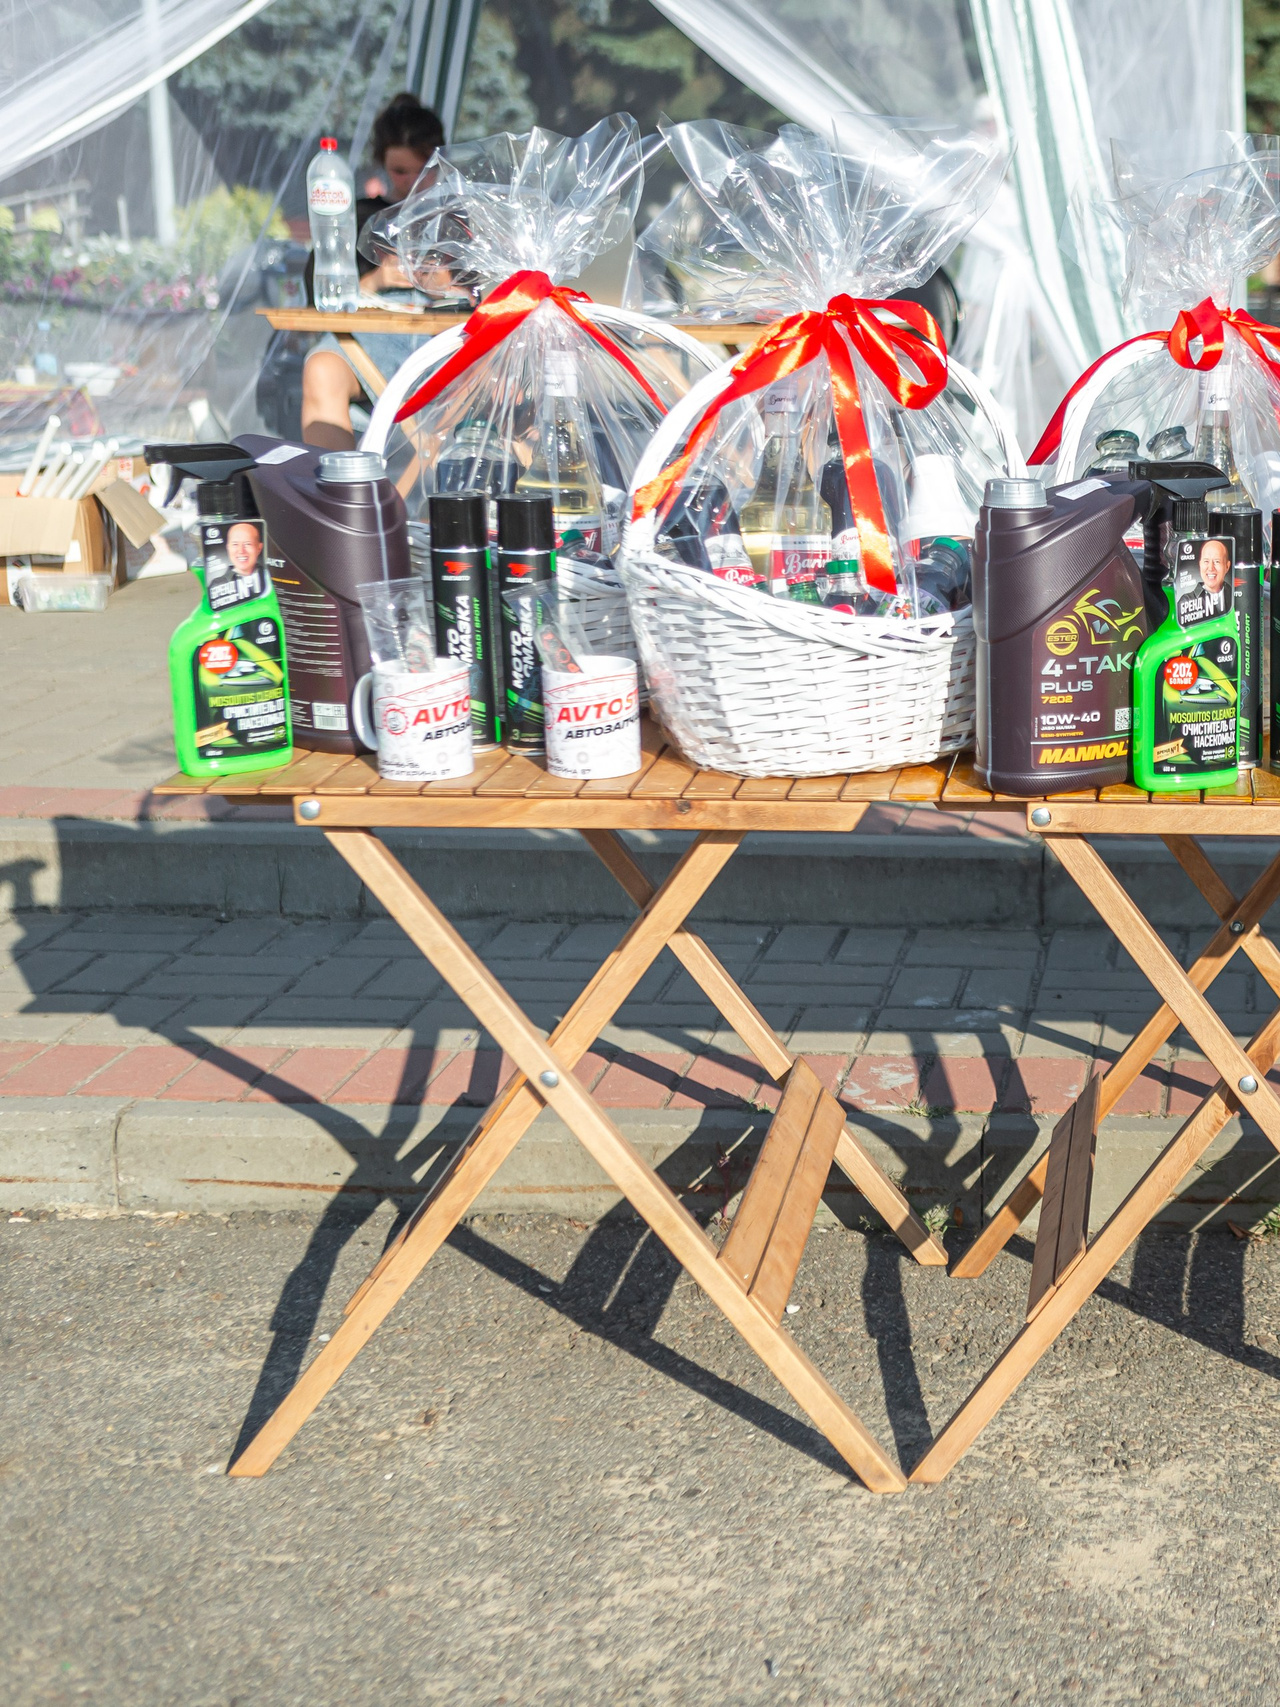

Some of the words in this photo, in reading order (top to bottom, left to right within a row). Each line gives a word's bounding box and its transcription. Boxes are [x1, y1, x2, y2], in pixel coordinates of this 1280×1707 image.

[1181, 598, 1203, 615] БРЕНД
[1047, 634, 1078, 643] ESTER
[1041, 651, 1134, 678] 4-TAK
[1217, 655, 1234, 663] GRASS
[1172, 663, 1193, 678] 20%
[1041, 680, 1094, 694] PLUS
[1040, 695, 1073, 704] 7202
[1040, 711, 1101, 726] 10W-40
[1169, 709, 1211, 724] MOSQUITOS
[1211, 707, 1236, 721] CLEANER
[1182, 721, 1229, 736] ОЧИСТИТЕЛЬ
[1194, 731, 1236, 749] НАСЕКОМЫХ
[1039, 742, 1128, 764] MANNOL
